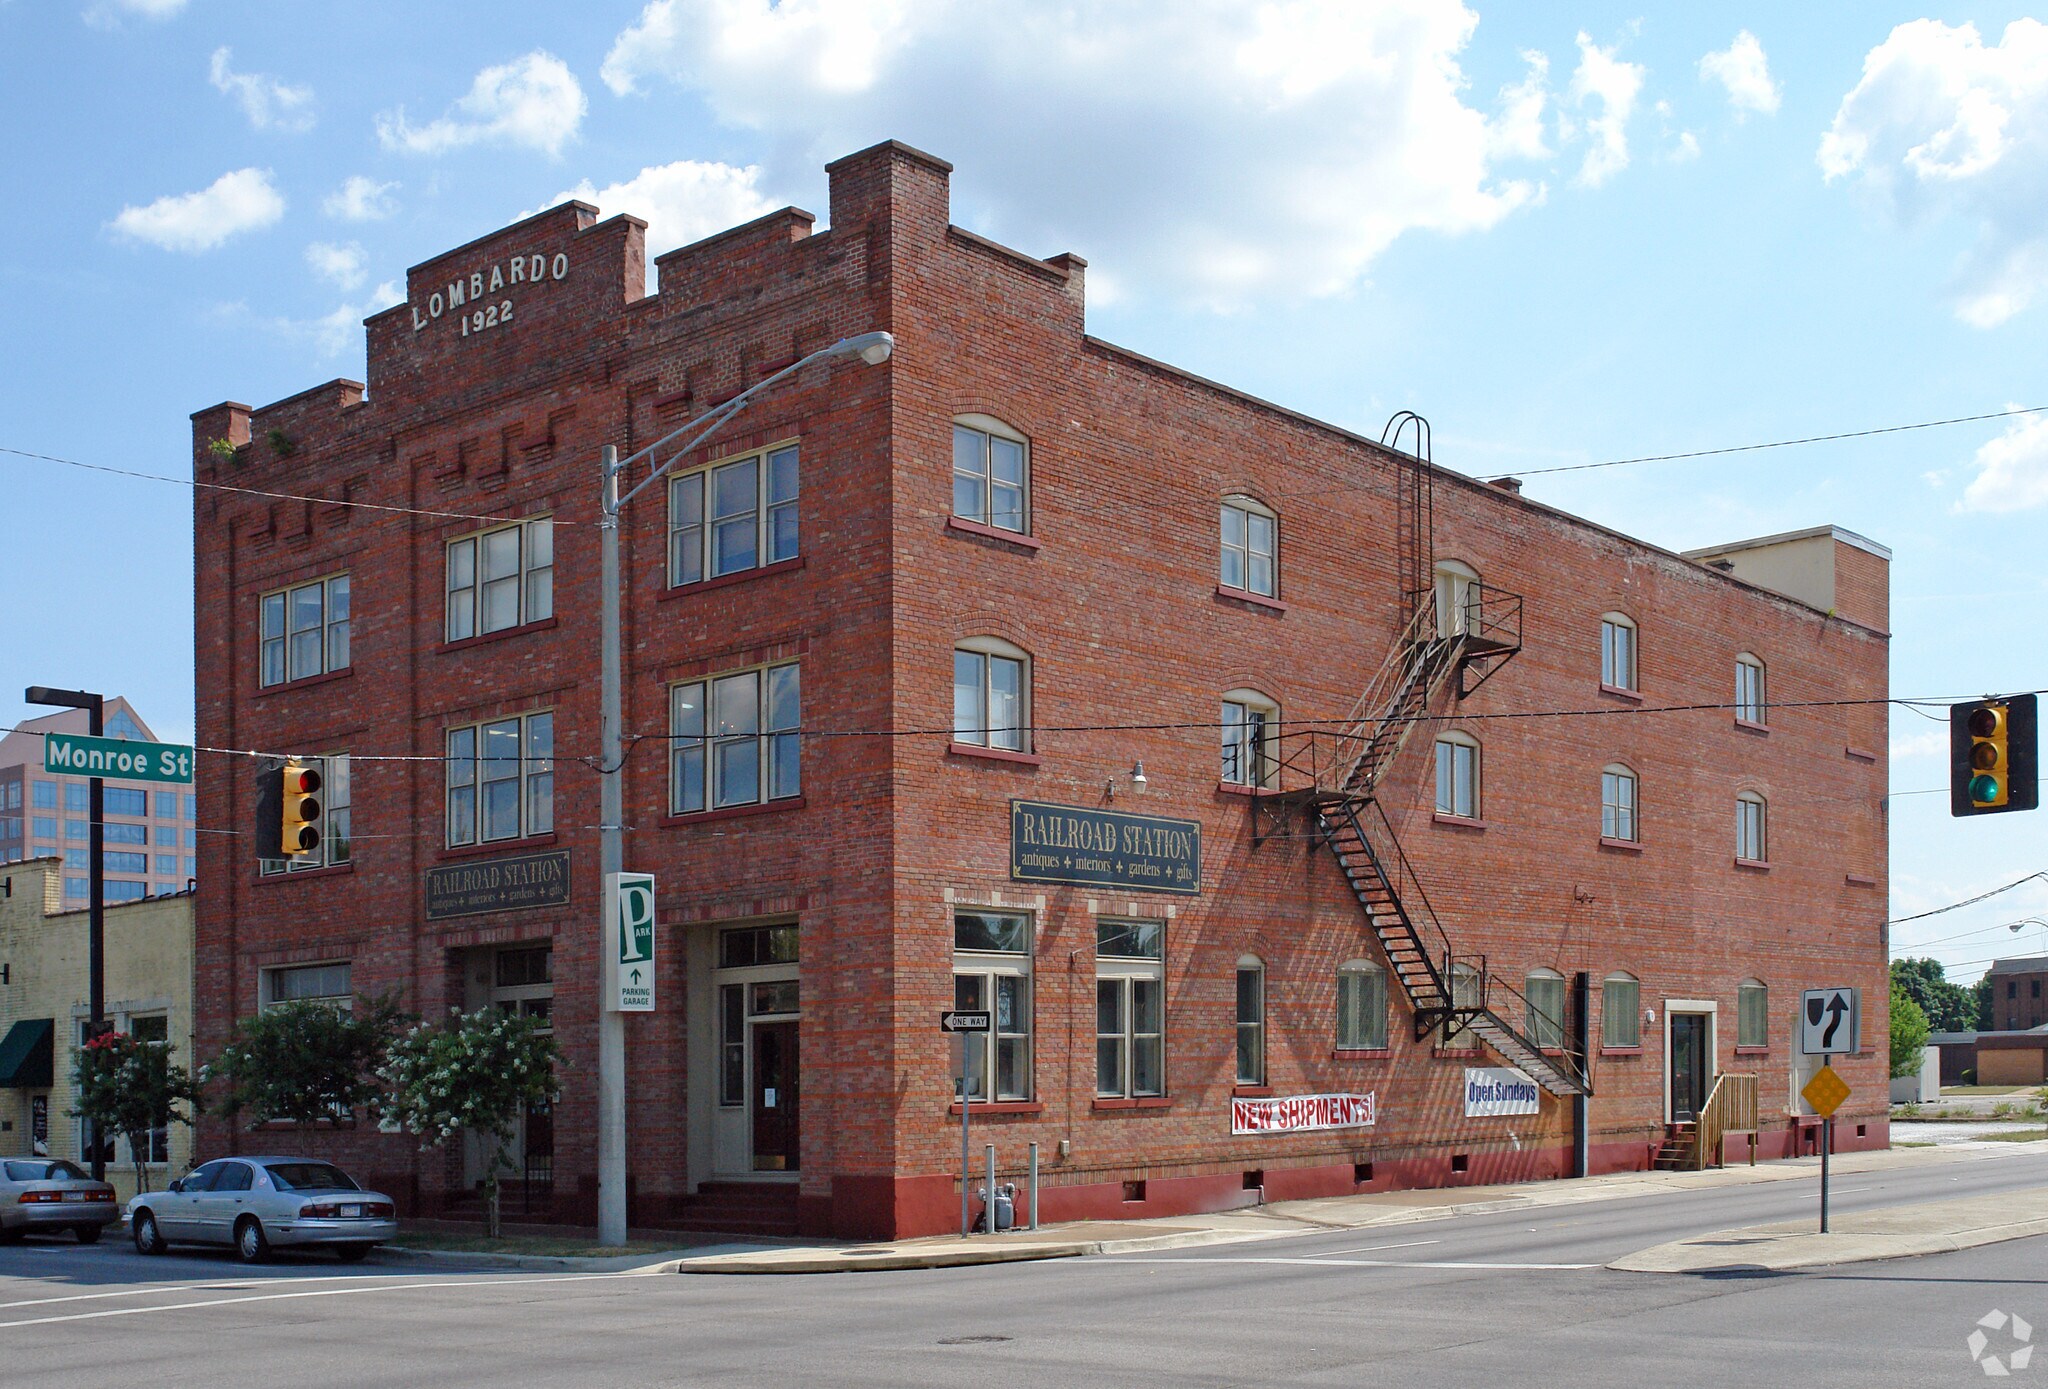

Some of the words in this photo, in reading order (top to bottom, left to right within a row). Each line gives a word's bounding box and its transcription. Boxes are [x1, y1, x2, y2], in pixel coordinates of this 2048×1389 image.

[412, 253, 569, 331] LOMBARDO
[462, 300, 514, 336] 1922
[50, 741, 148, 773] Monroe
[159, 751, 188, 776] St
[1022, 813, 1117, 852] RAILROAD
[1122, 824, 1192, 860] STATION
[433, 867, 500, 895] RAILROAD
[504, 858, 562, 887] STATION
[1021, 848, 1060, 871] antiques
[1075, 852, 1111, 872] interiors
[1128, 859, 1160, 877] gardens
[1176, 862, 1193, 882] gifts
[509, 887, 536, 901] gardens
[622, 987, 650, 996] PARKING
[623, 997, 649, 1006] GARAGE
[952, 1017, 967, 1026] ONE
[970, 1017, 986, 1026] WAY
[1469, 1082, 1494, 1104] Open
[1496, 1081, 1536, 1103] Sundays
[1234, 1102, 1273, 1130] NEW
[1278, 1095, 1373, 1128] SHIPMENTS!
